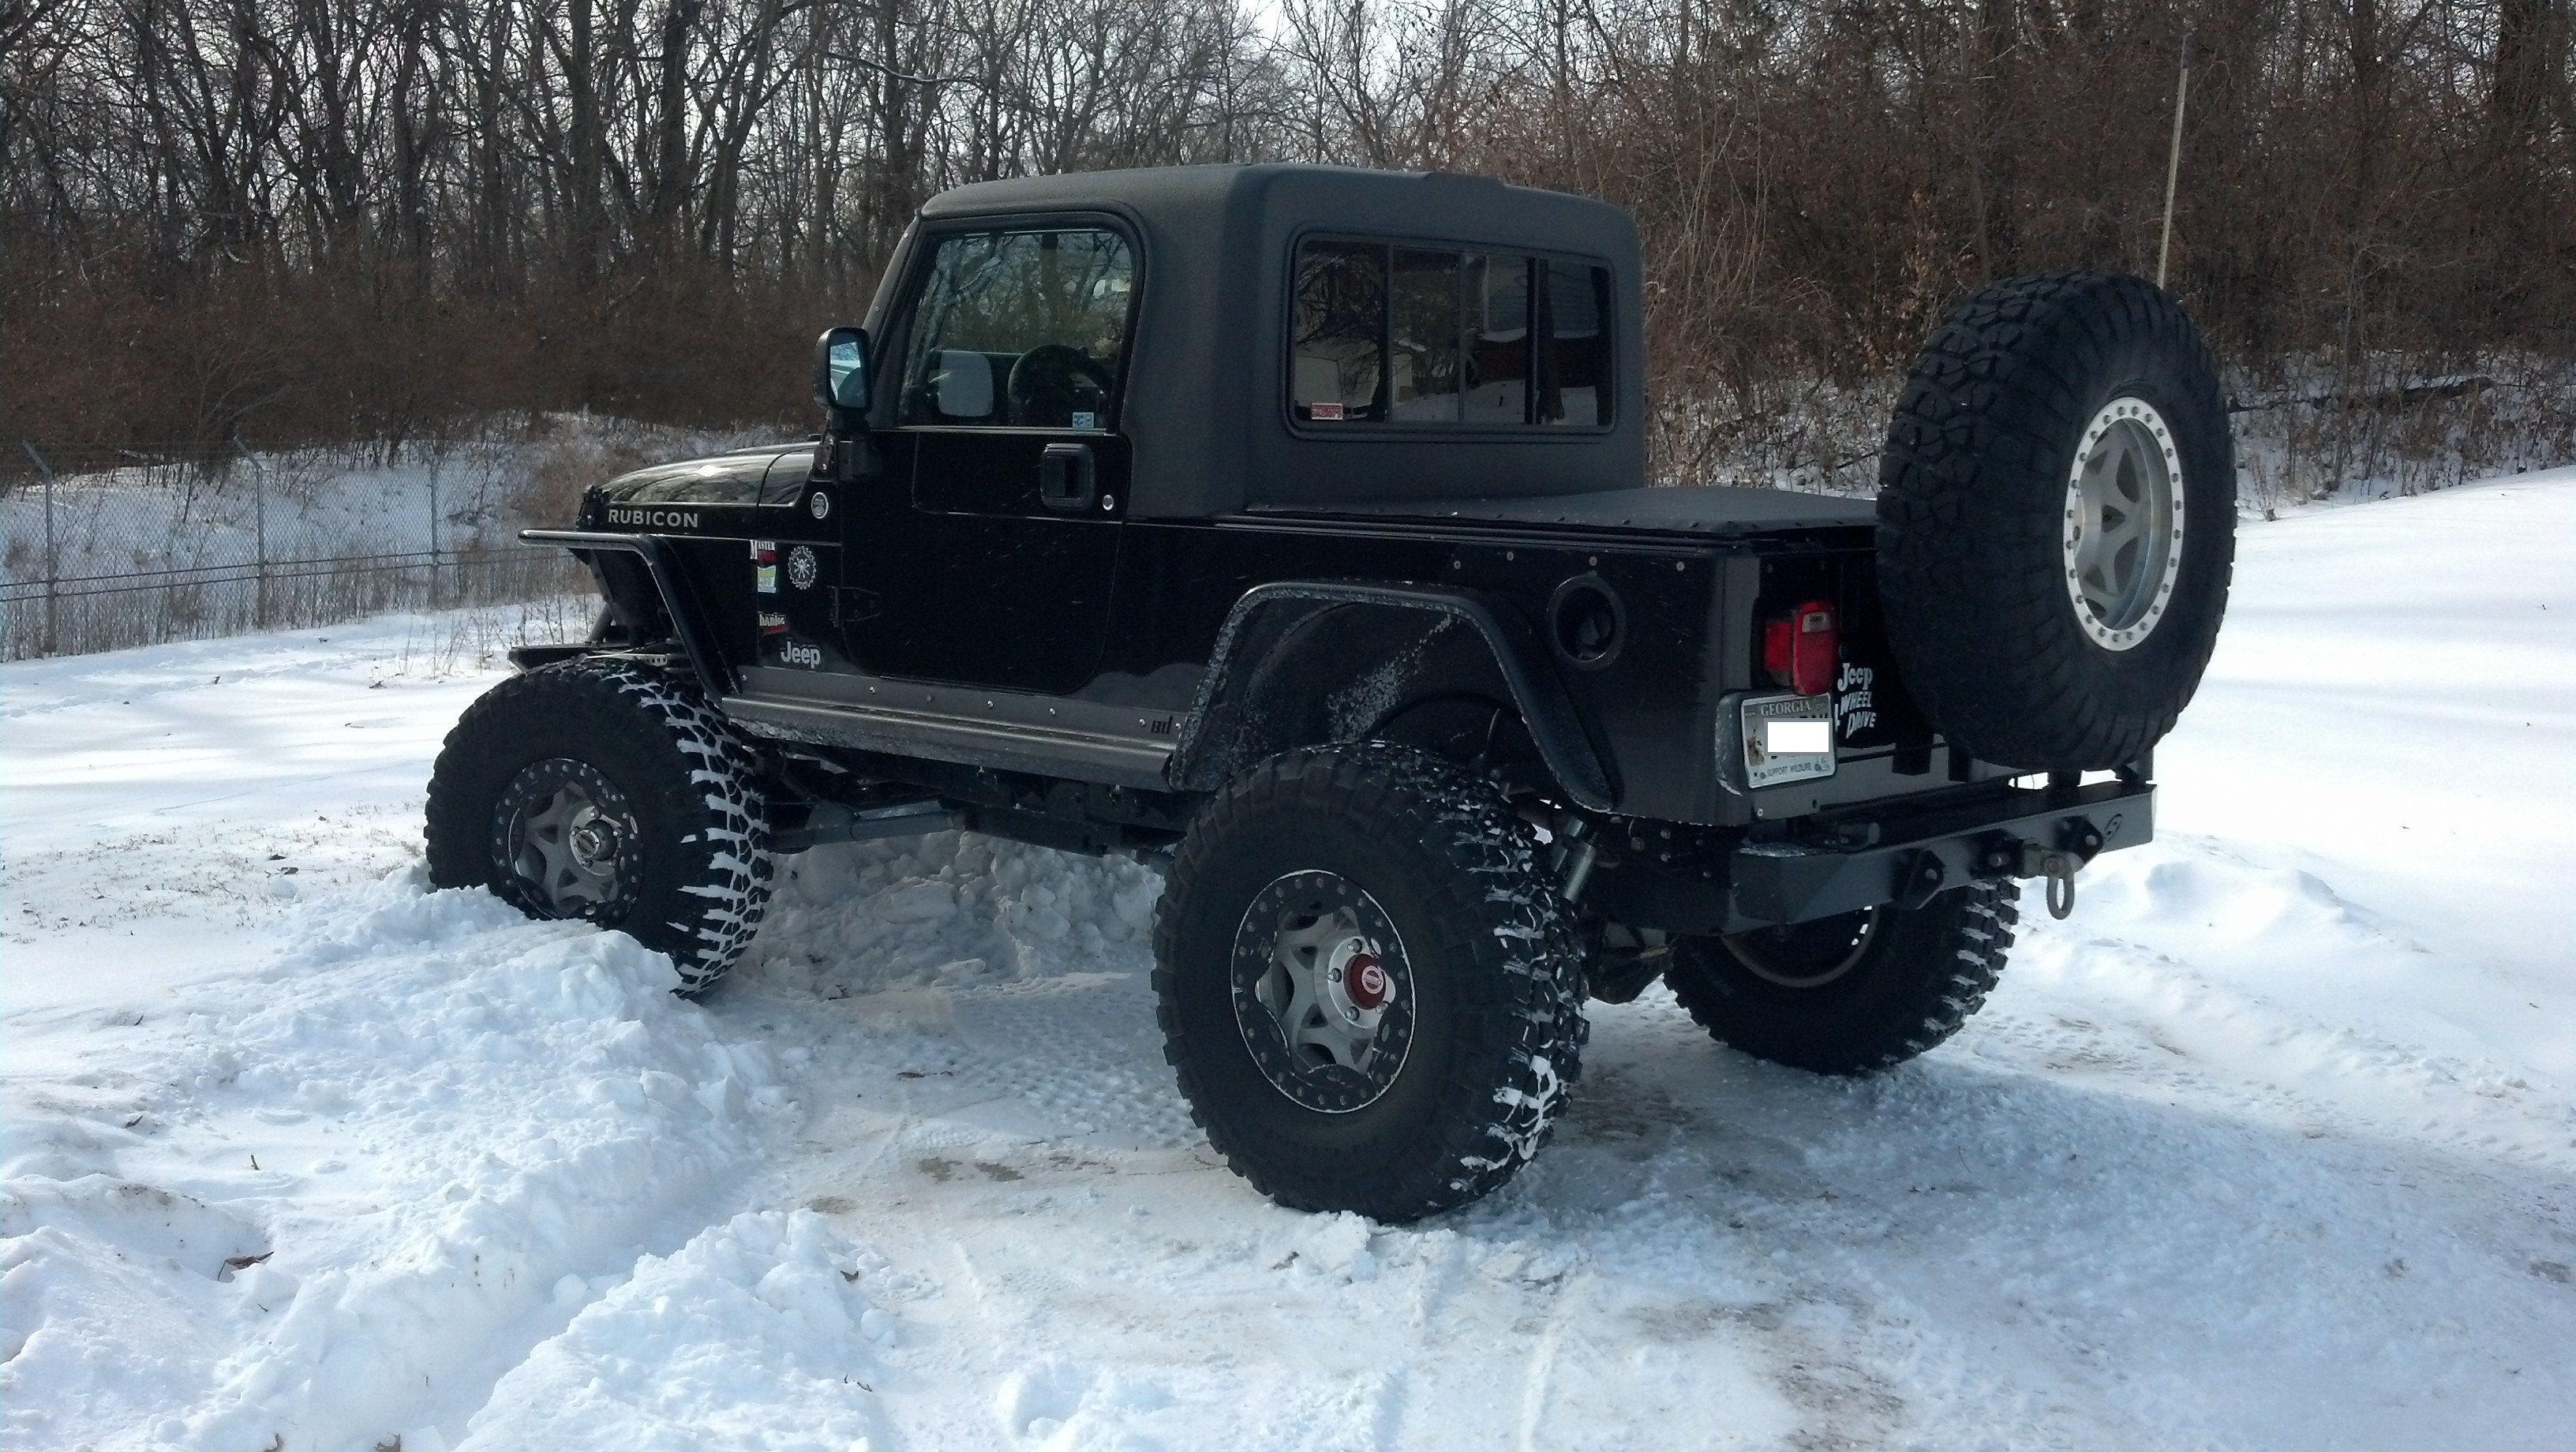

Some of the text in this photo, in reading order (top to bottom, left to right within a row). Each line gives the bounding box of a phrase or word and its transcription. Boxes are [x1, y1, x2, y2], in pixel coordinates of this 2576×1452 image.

[608, 509, 698, 528] RUBICON
[781, 641, 821, 668] Jeep
[1837, 662, 1873, 691] Jeep
[1761, 700, 1811, 717] GEORGIA
[1840, 690, 1872, 716] WHEEL
[1845, 711, 1877, 739] DRIVE
